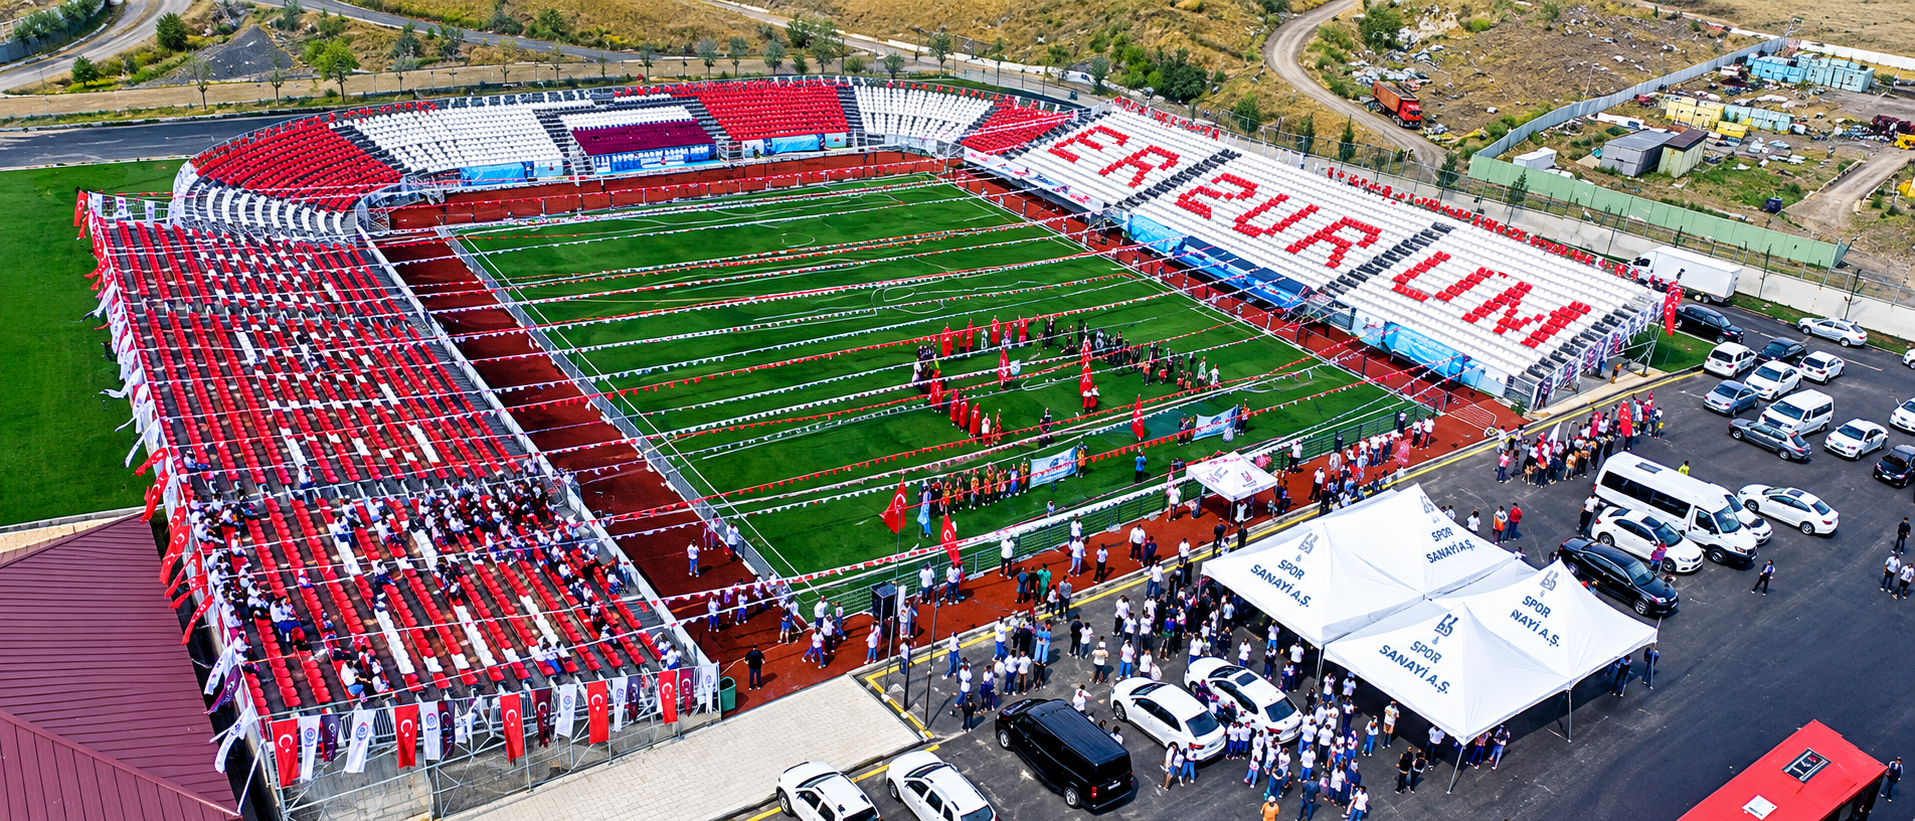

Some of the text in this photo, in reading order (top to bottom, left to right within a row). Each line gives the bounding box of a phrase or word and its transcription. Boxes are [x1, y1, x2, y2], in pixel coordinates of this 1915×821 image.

[1431, 526, 1454, 543] SPOR
[1277, 559, 1305, 581] SPOR
[1250, 563, 1311, 608] SANAYİ A.Ş.
[1522, 595, 1551, 618] SPOR
[1537, 628, 1560, 648] A.Ş.
[1410, 640, 1443, 665] SPOR
[1378, 643, 1451, 695] SANAYİ A.Ş.
